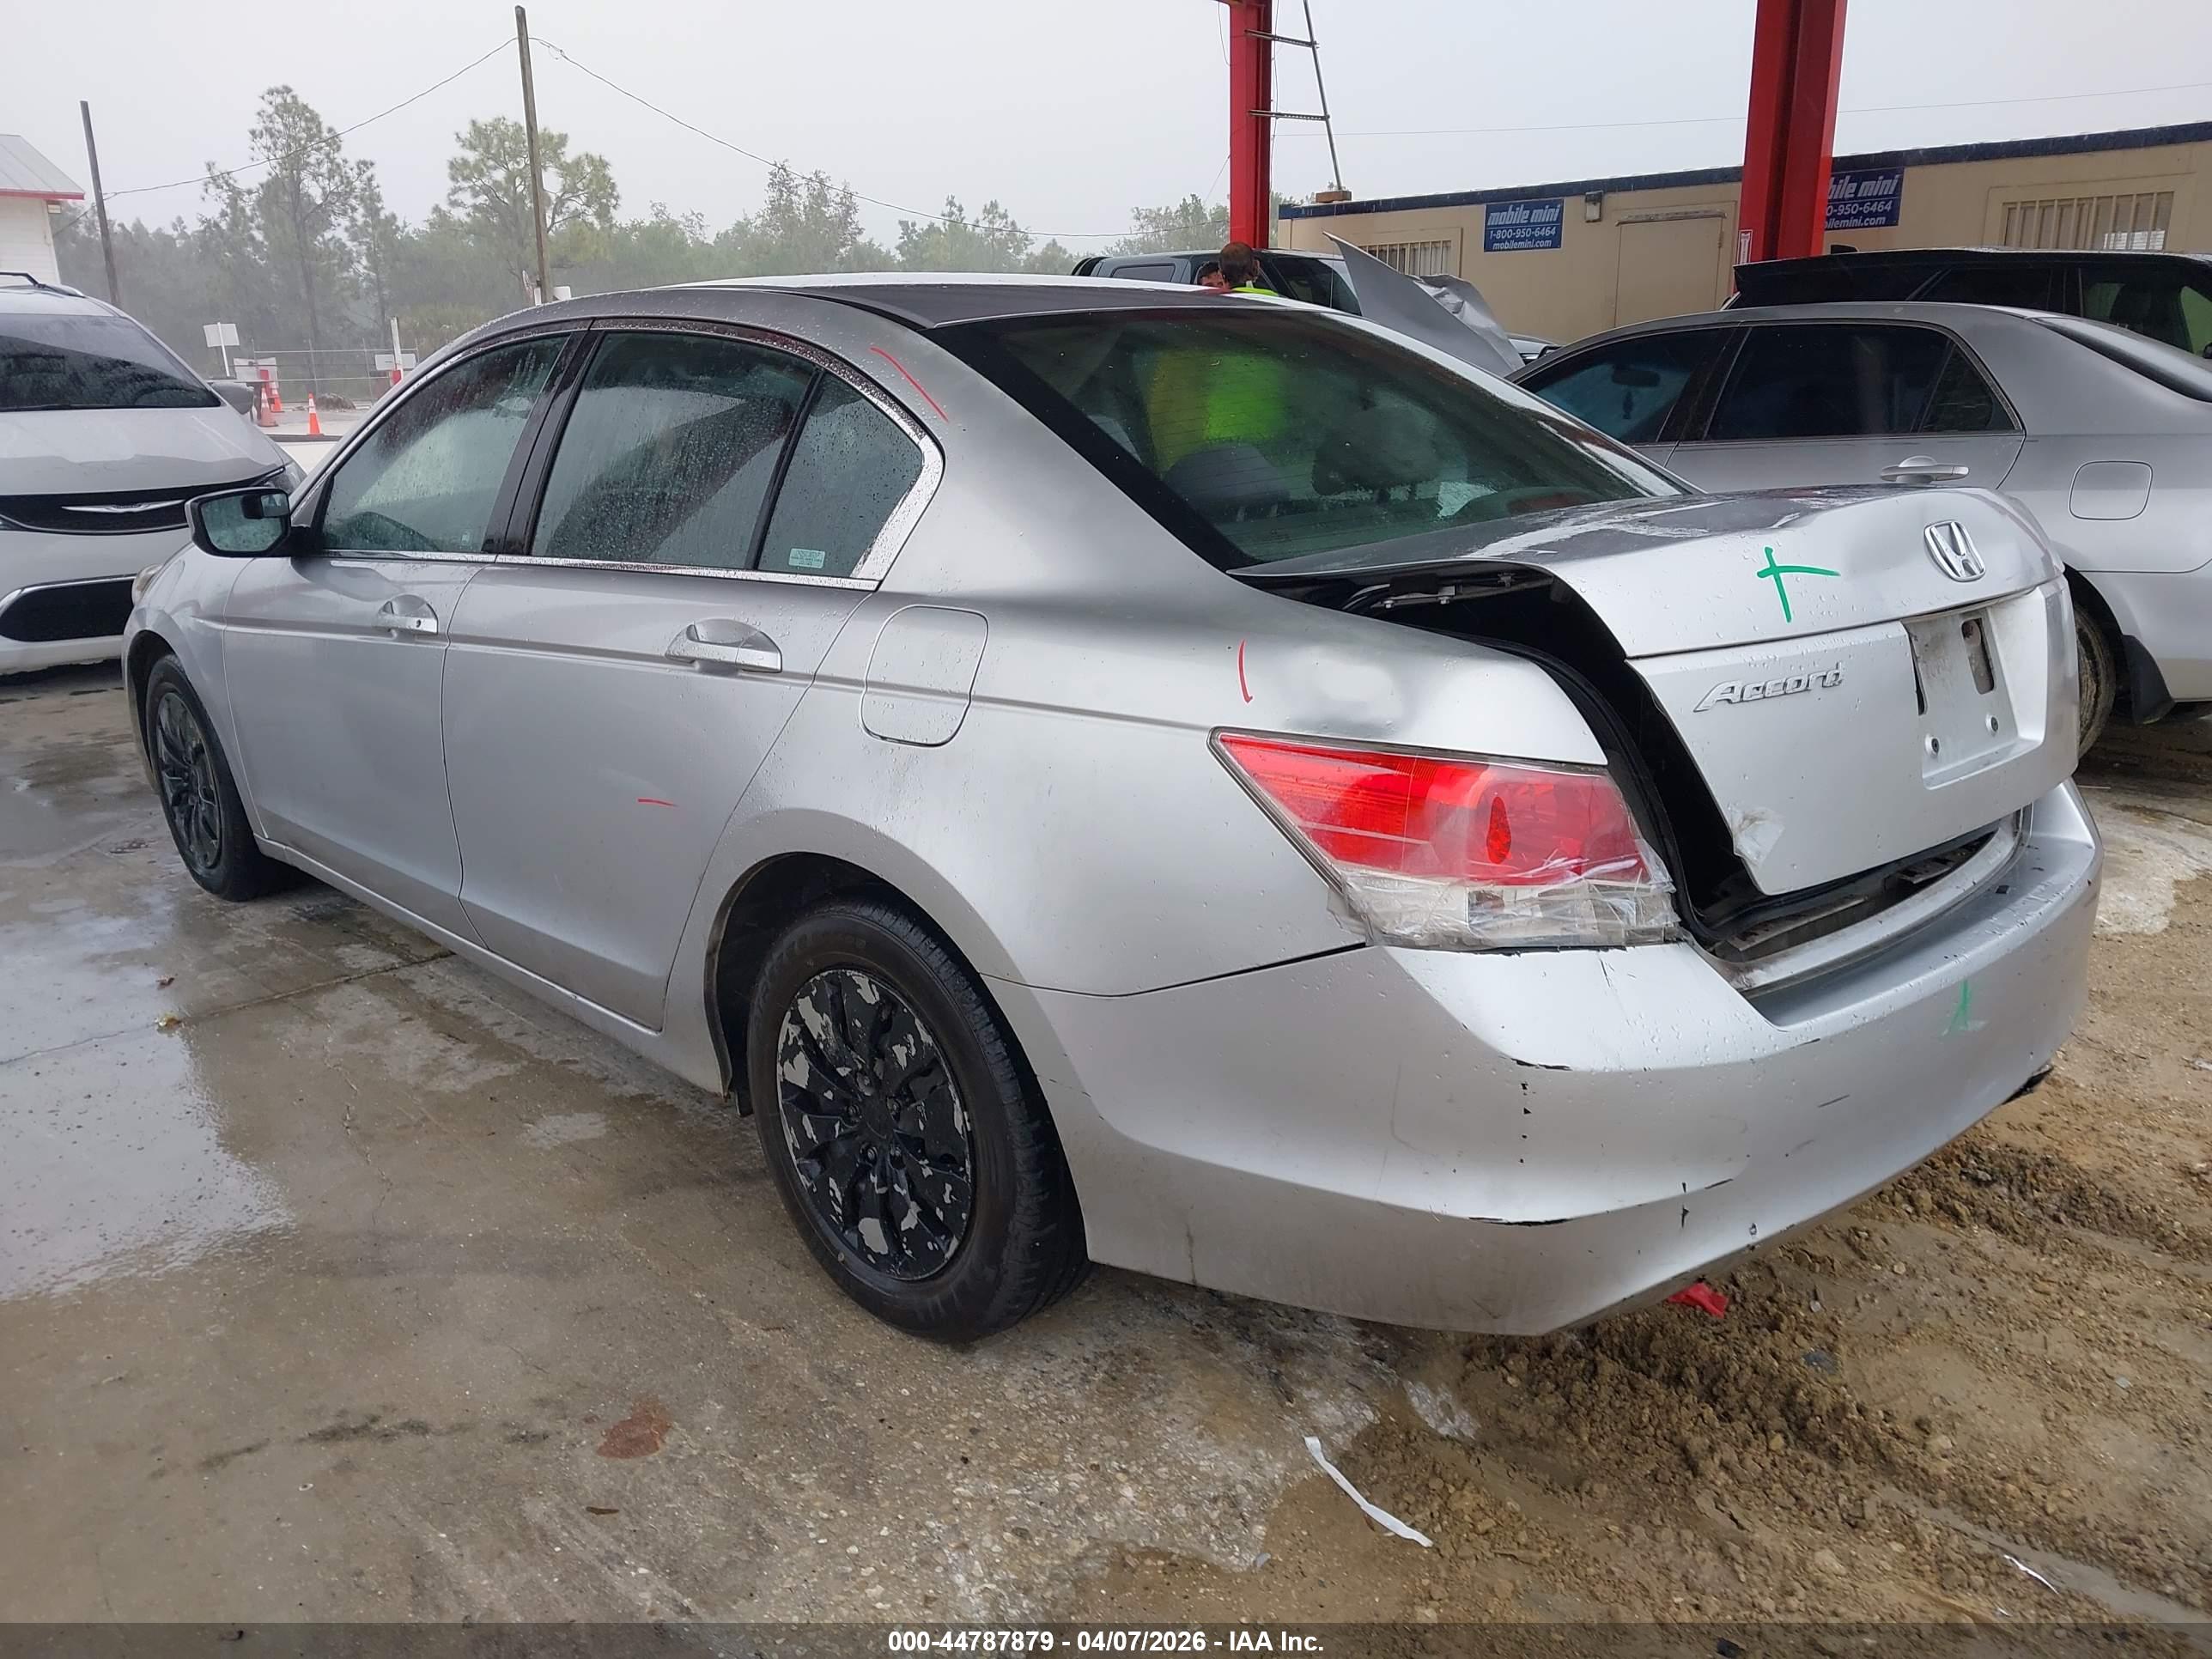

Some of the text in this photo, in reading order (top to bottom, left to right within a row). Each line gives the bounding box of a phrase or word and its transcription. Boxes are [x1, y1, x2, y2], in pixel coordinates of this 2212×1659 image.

[1827, 174, 1899, 199] bile mini
[1487, 204, 1560, 226] mobile mini
[1826, 200, 1893, 216] 0-950-6464
[1825, 216, 1886, 228] ilemini.com
[1490, 227, 1556, 240] 1-800-950-6464
[1492, 240, 1552, 250] mobilemini.com
[1693, 661, 1844, 712] Accord
